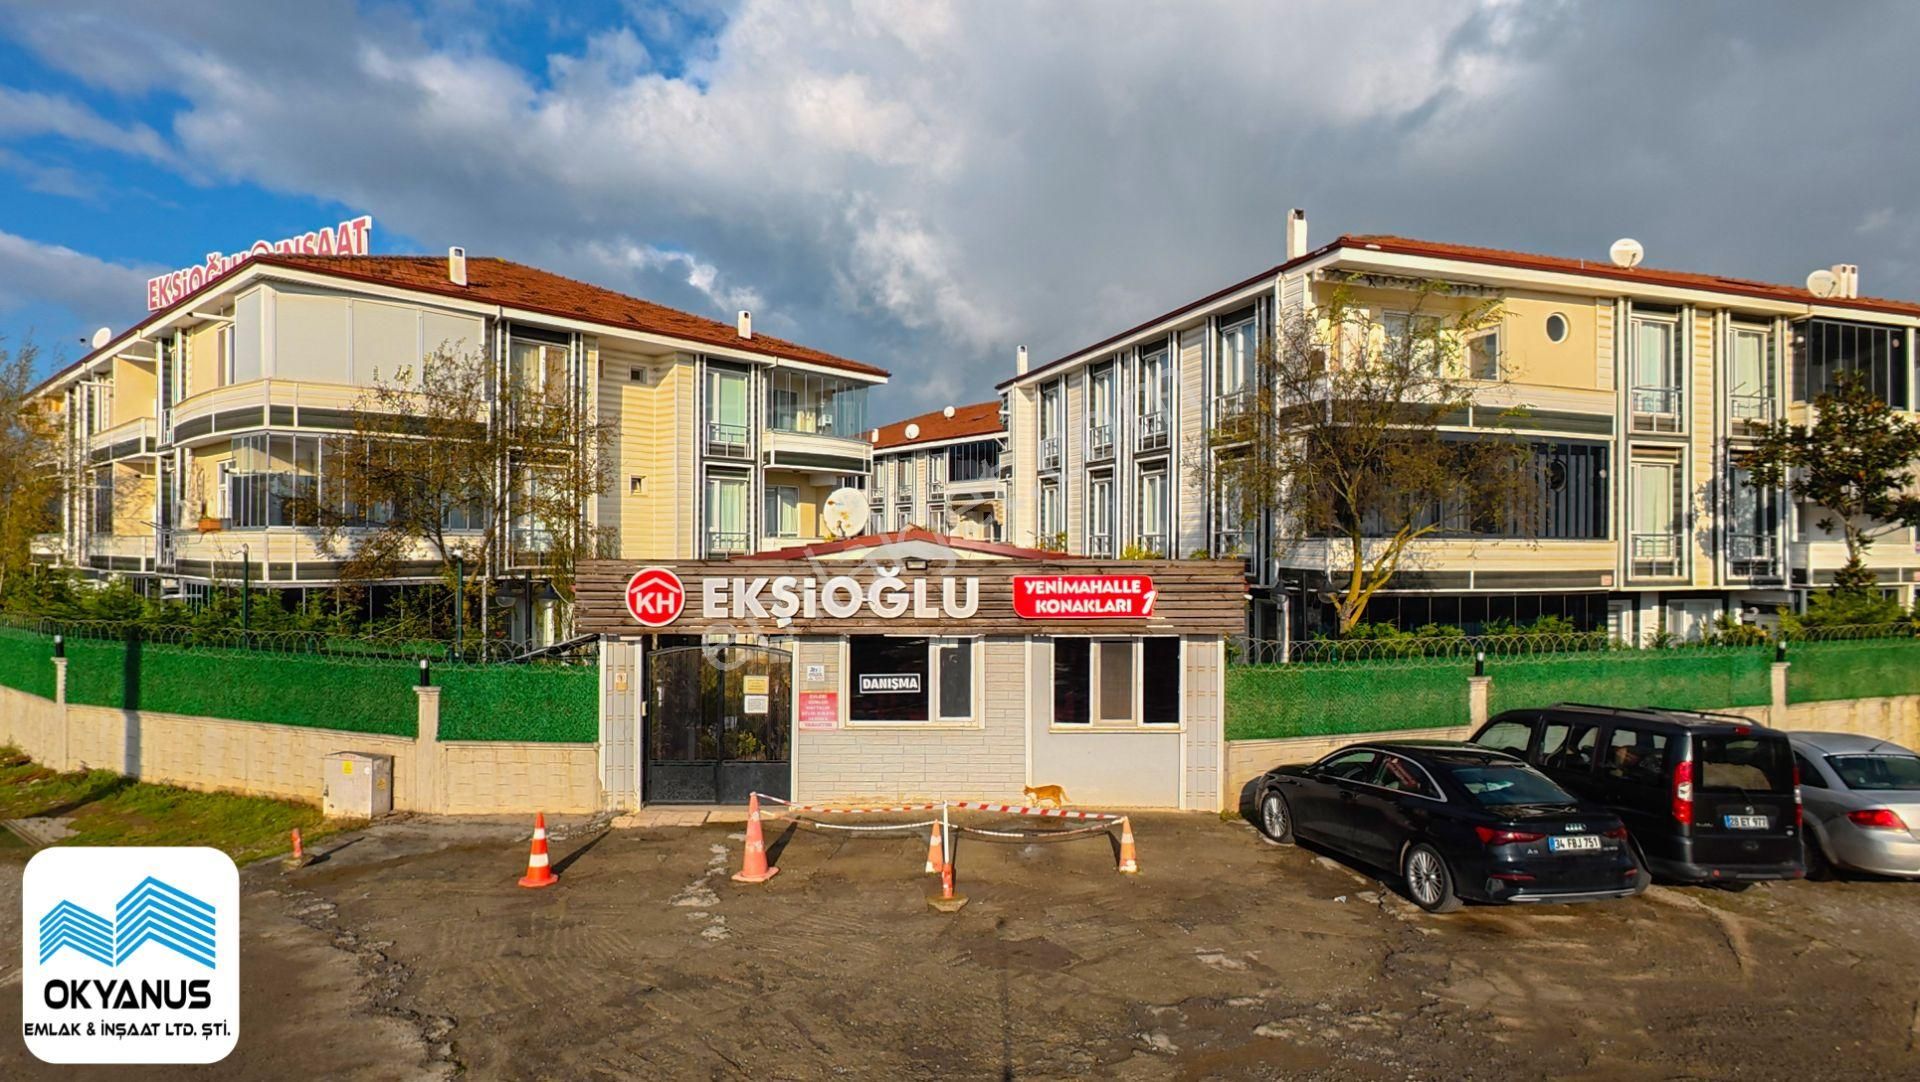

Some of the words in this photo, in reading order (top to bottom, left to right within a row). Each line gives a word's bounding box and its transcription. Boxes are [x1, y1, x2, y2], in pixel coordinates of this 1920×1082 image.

[1024, 577, 1141, 594] YENİMAHALLE
[636, 592, 675, 615] KH
[1035, 599, 1132, 614] KONAKLARI
[1142, 590, 1156, 615] 1
[862, 678, 918, 690] DANIŞMA
[1554, 839, 1565, 849] 34
[1567, 838, 1582, 849] FBJ
[1583, 837, 1598, 848] 751
